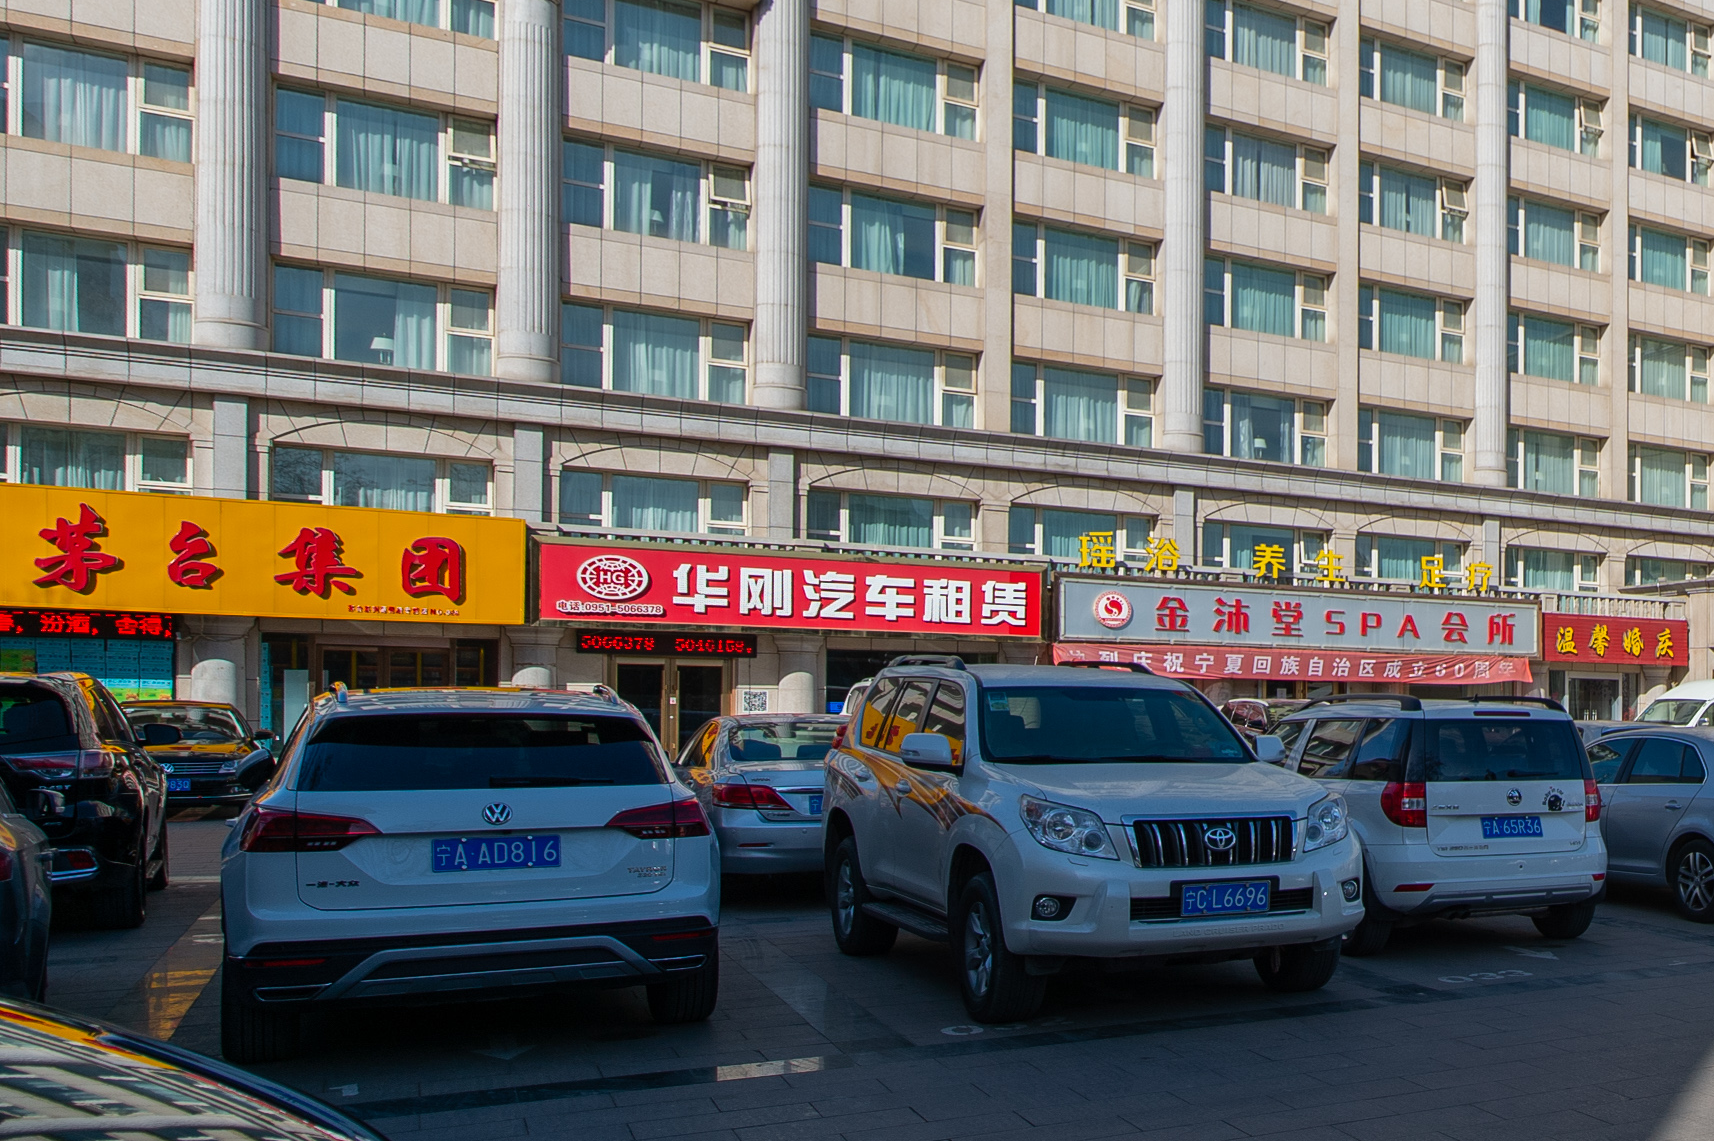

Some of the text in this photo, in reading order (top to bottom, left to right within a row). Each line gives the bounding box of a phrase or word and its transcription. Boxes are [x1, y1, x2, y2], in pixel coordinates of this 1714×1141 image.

[33, 502, 464, 604] 茅台集团
[600, 571, 625, 583] HG
[1079, 531, 1493, 591] 瑶浴 养生 足疗
[673, 563, 1027, 626] 华刚汽车租赁
[1556, 623, 1674, 658] 温馨婚庆
